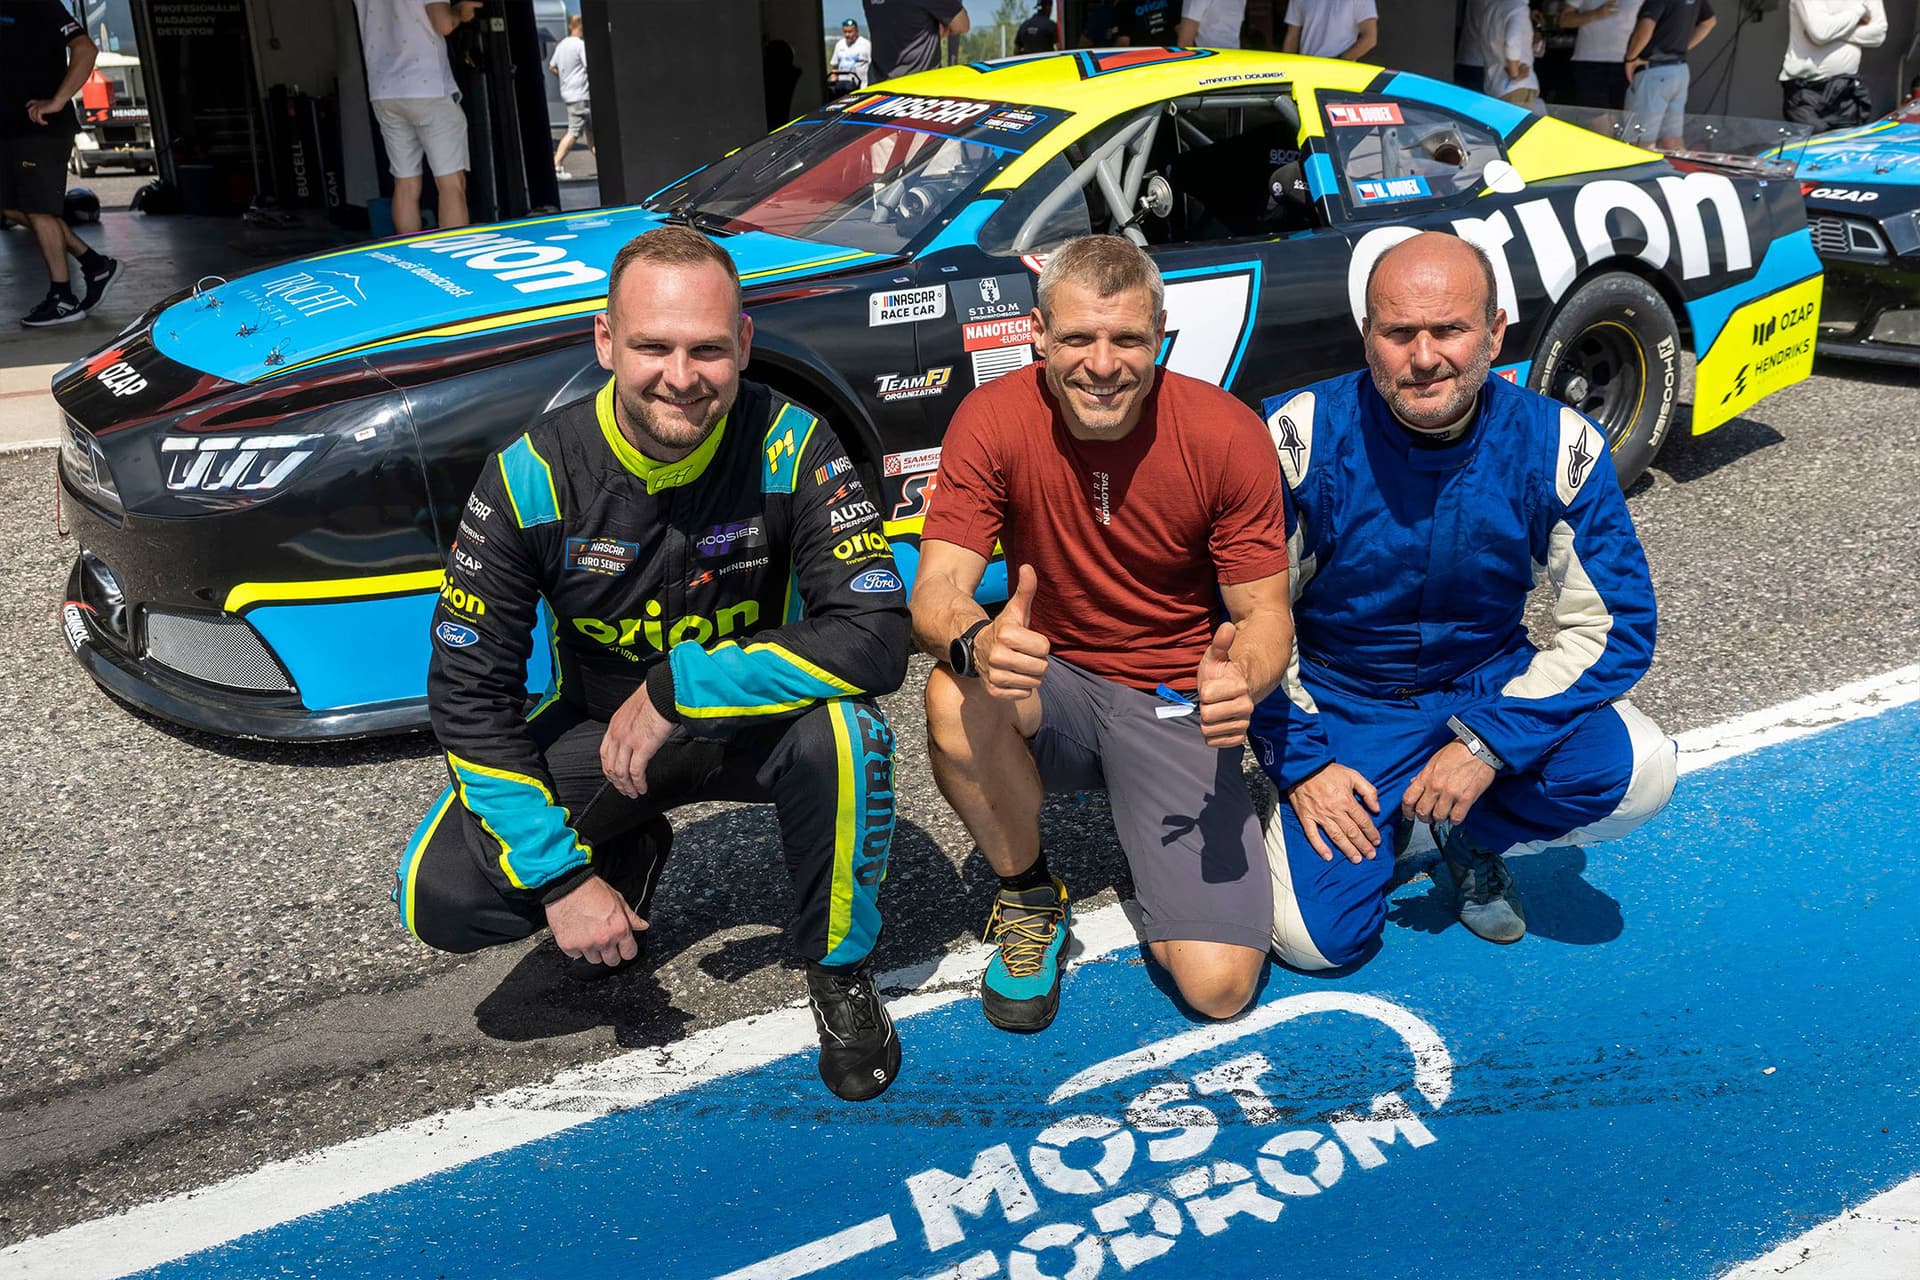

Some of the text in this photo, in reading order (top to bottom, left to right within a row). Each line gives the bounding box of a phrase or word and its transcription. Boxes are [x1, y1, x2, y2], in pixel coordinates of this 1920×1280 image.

[112, 109, 149, 118] HENDRI
[865, 96, 990, 125] NASCAR
[1810, 187, 1879, 203] OZAP
[407, 232, 608, 294] orion
[261, 271, 358, 318] TRACHT
[894, 290, 936, 307] NASCAR
[880, 304, 936, 320] RACE CAR
[968, 302, 1020, 316] STROM
[1780, 302, 1814, 331] OZAP
[965, 319, 1032, 340] NANOTECH
[1754, 337, 1811, 376] HENDRIKS
[97, 361, 149, 398] OZAP
[884, 387, 943, 402] ORGANIZATION
[1647, 356, 1675, 447] HOOSIER
[831, 455, 855, 477] NAS
[902, 452, 941, 466] SAMSO
[467, 491, 494, 522] SCAR
[1101, 472, 1111, 526] SALOMON
[695, 526, 760, 549] HOOSIER
[590, 542, 626, 557] NASCAR
[577, 556, 626, 572] EURO SERIES
[718, 556, 769, 577] HENDRIKS
[862, 573, 896, 590] Ford
[442, 623, 468, 645] Ford
[572, 599, 760, 652] orion
[907, 1051, 1282, 1252] MOST
[910, 1090, 1438, 1280] ODROM
